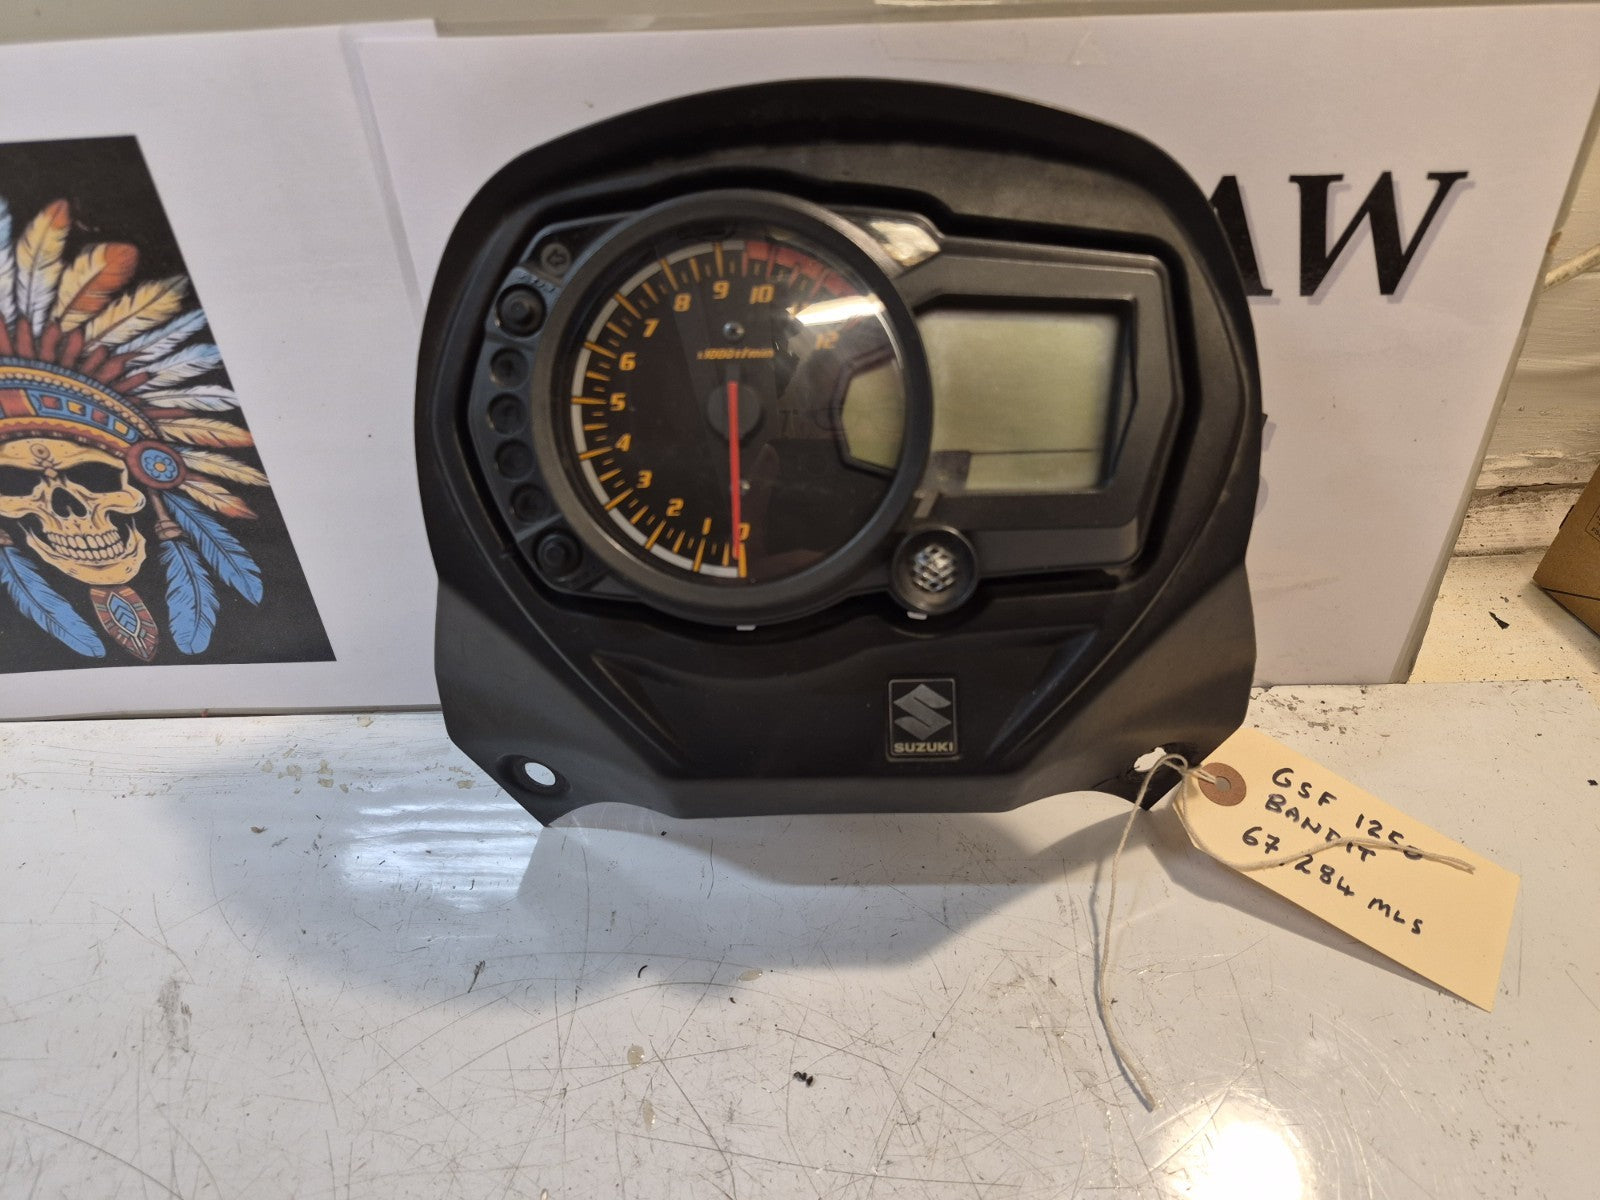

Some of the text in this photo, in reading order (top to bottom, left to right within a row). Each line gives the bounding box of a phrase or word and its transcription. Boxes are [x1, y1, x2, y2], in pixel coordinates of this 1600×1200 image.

[713, 280, 730, 299] 9
[750, 284, 775, 304] 10
[673, 293, 692, 312] 8
[643, 318, 660, 337] 7
[619, 352, 637, 371] 6
[610, 392, 627, 411] 5
[615, 433, 632, 452] 4
[637, 470, 653, 489] 3
[666, 498, 684, 517] 2
[702, 517, 712, 536] 1
[894, 742, 954, 753] SUZUKI
[1272, 767, 1337, 806] GSF
